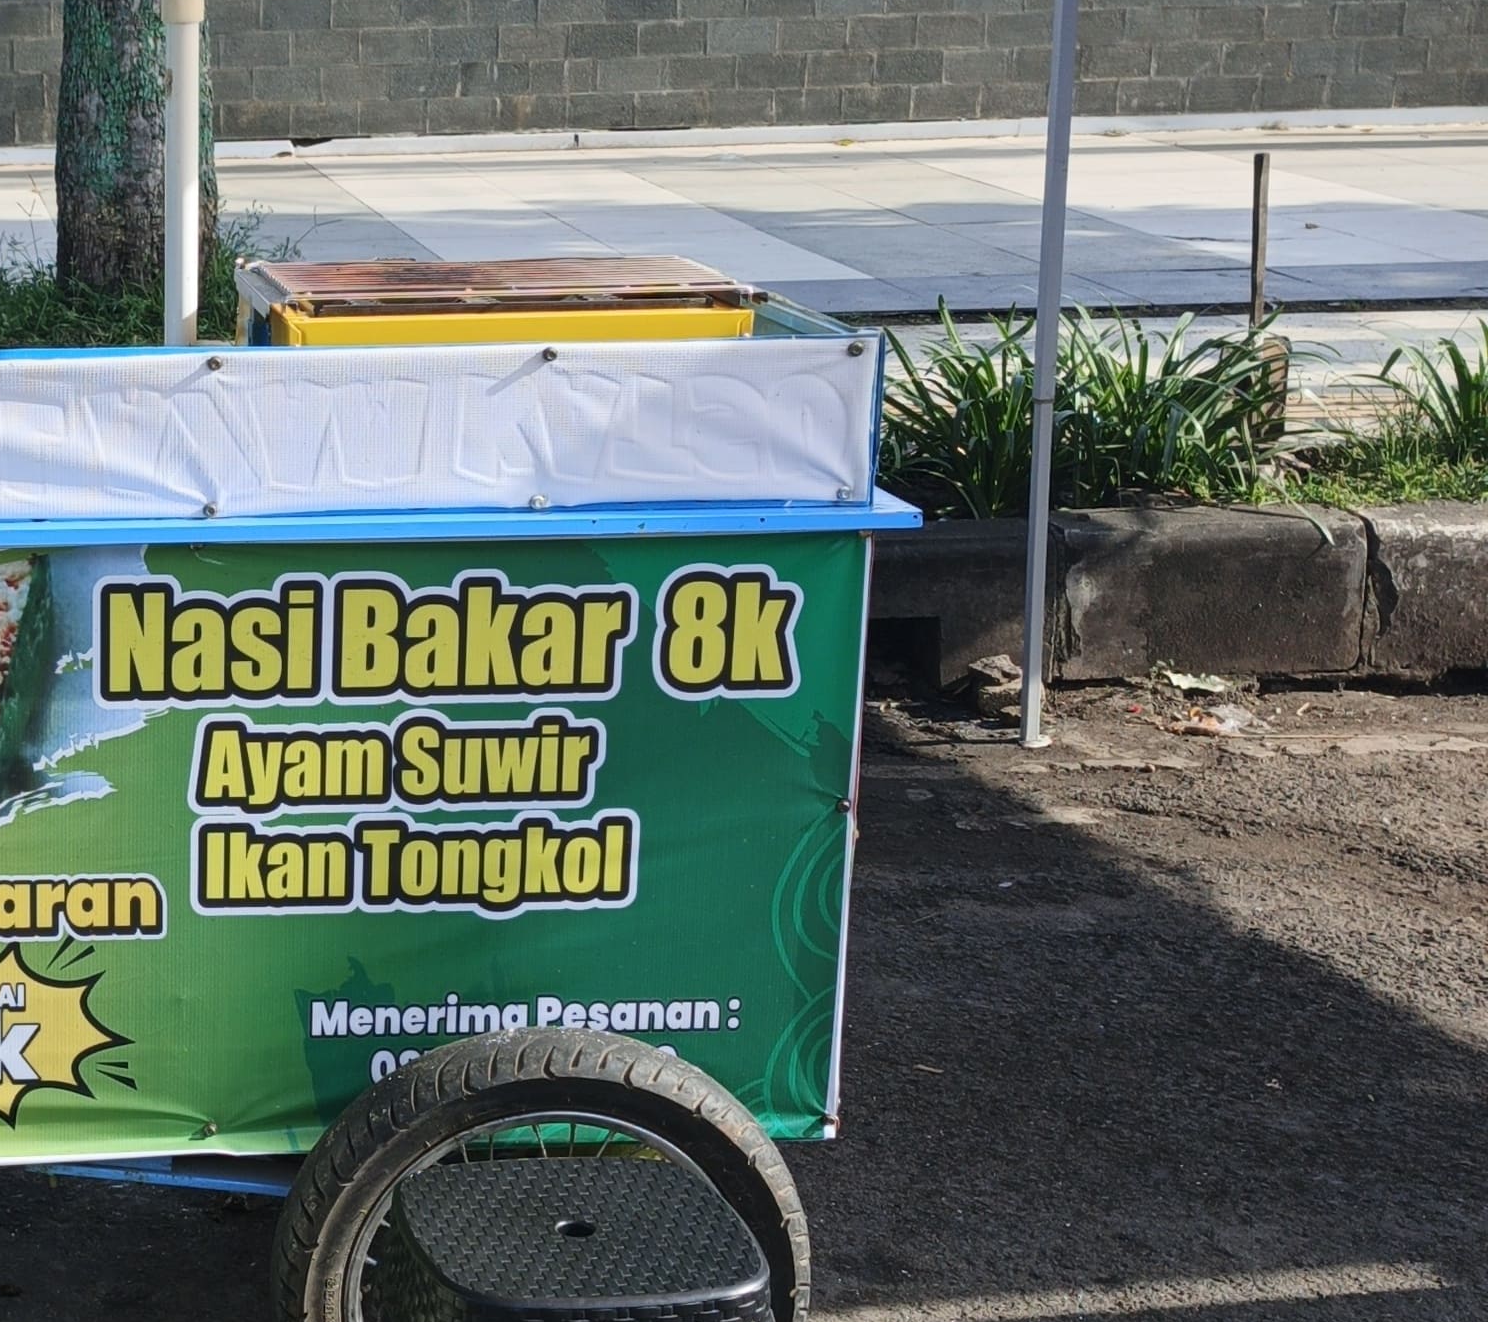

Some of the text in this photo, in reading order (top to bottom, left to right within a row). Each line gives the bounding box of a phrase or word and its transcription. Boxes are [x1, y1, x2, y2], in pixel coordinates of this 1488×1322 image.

[104, 576, 794, 696] Nasi Bakar 8k
[199, 719, 596, 809] Ayam Suwir
[202, 819, 626, 907] Ikan Tongkol
[310, 994, 529, 1036] Menerima
